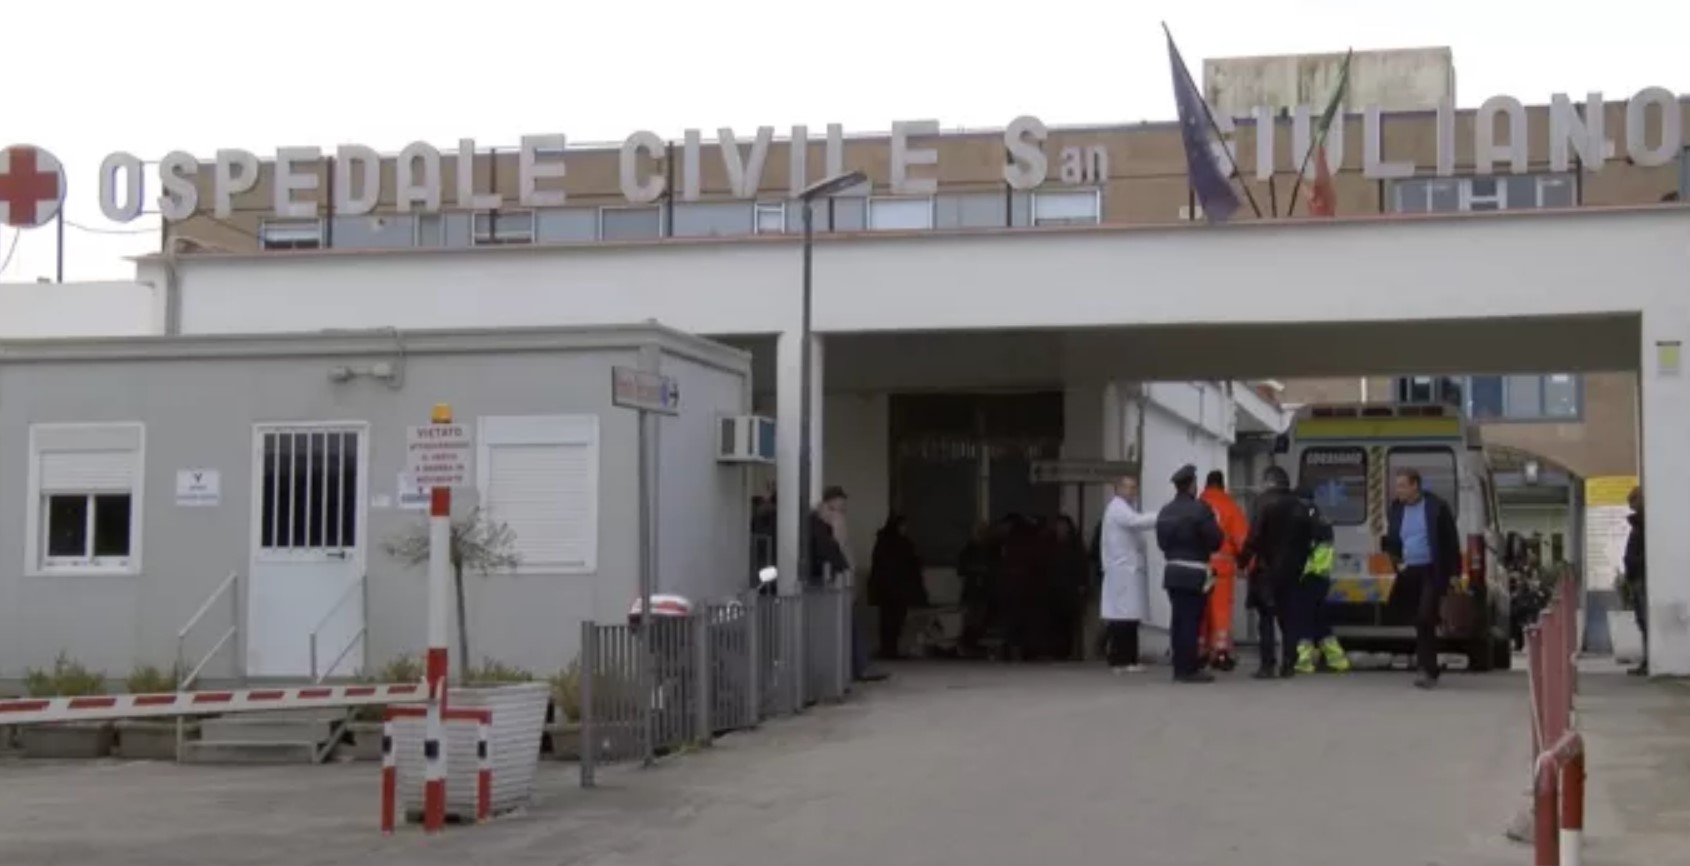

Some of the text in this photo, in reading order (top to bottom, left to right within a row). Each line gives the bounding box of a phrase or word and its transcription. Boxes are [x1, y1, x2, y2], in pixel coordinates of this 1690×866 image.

[98, 133, 567, 222] OSPEDALE
[620, 120, 940, 204] CIVILE
[1004, 115, 1108, 190] San
[416, 427, 463, 439] VIETATO
